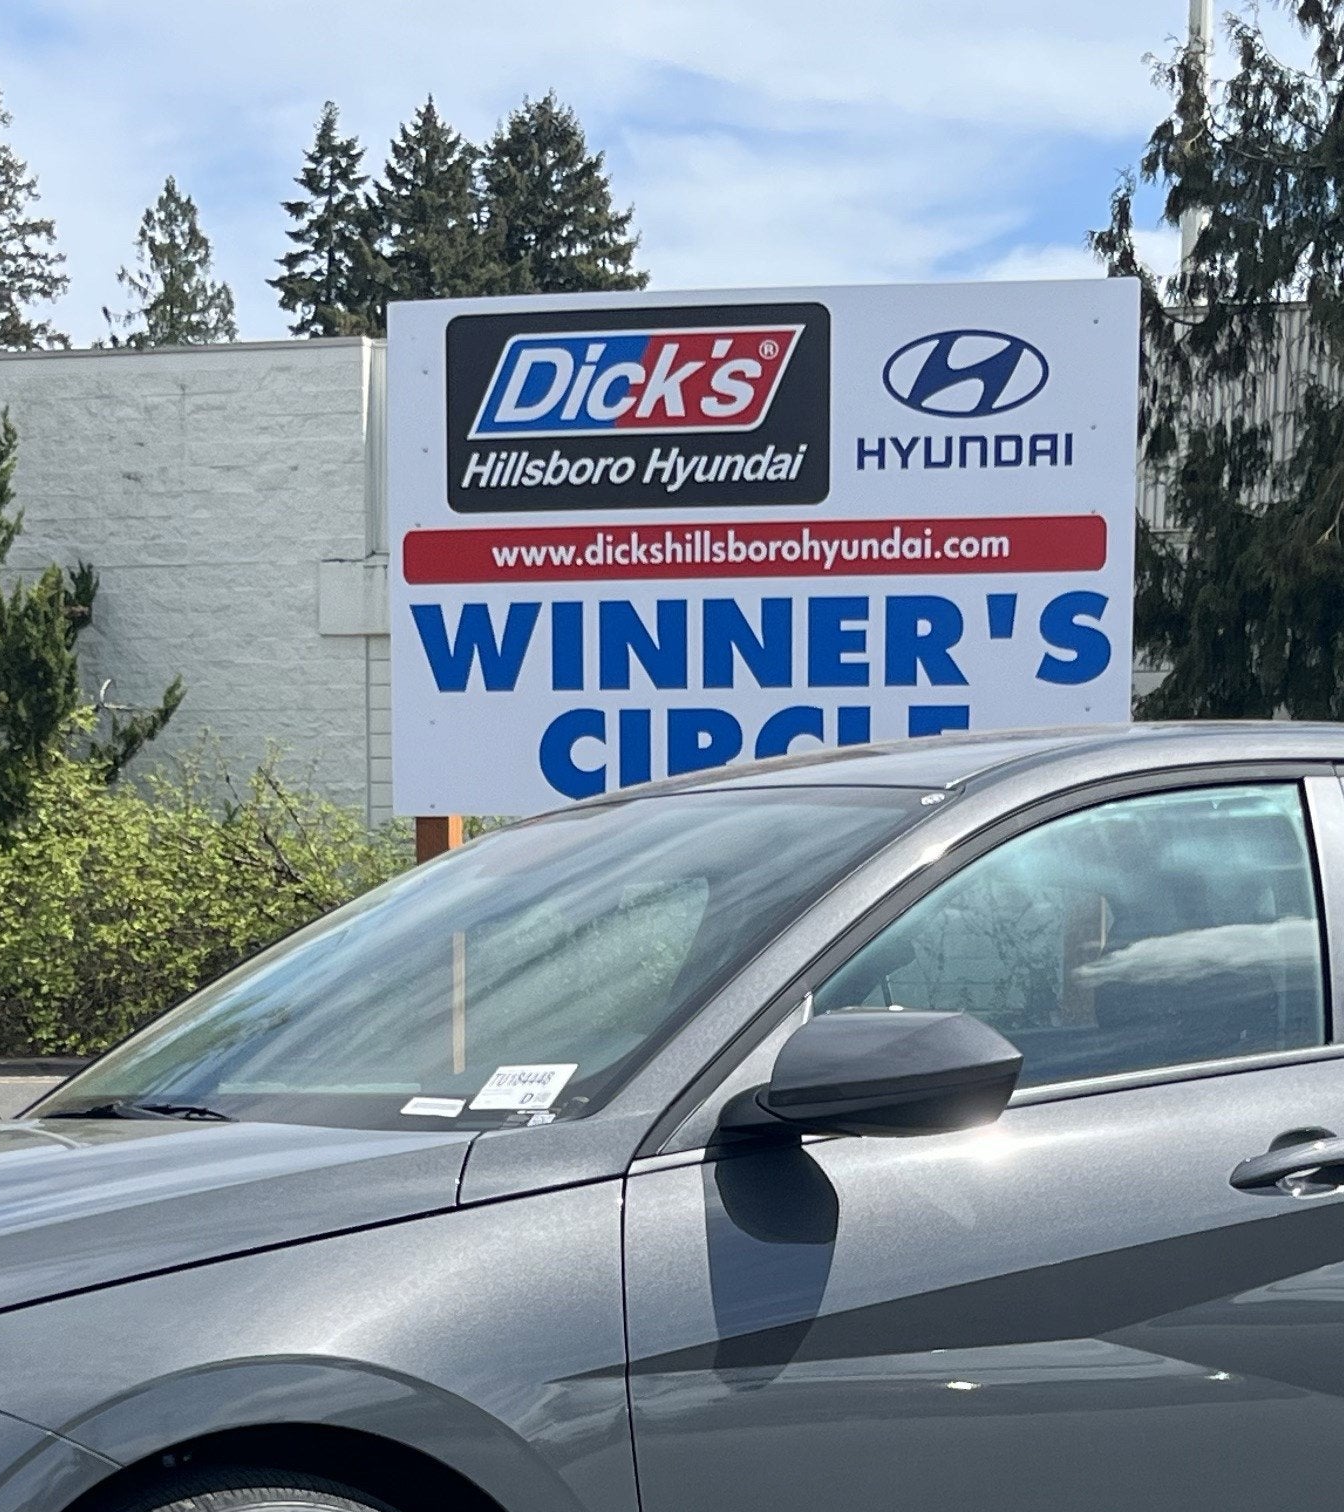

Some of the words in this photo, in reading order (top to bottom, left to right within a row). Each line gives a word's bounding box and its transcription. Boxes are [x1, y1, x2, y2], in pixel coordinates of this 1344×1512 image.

[494, 339, 762, 423] Dick's
[461, 450, 635, 488] Hillsboro
[643, 444, 807, 492] Hyundai
[857, 433, 1073, 470] HYUNDAI
[492, 526, 1010, 569] www.dickshillsborohyundai.com
[410, 590, 1112, 692] WINNER'S
